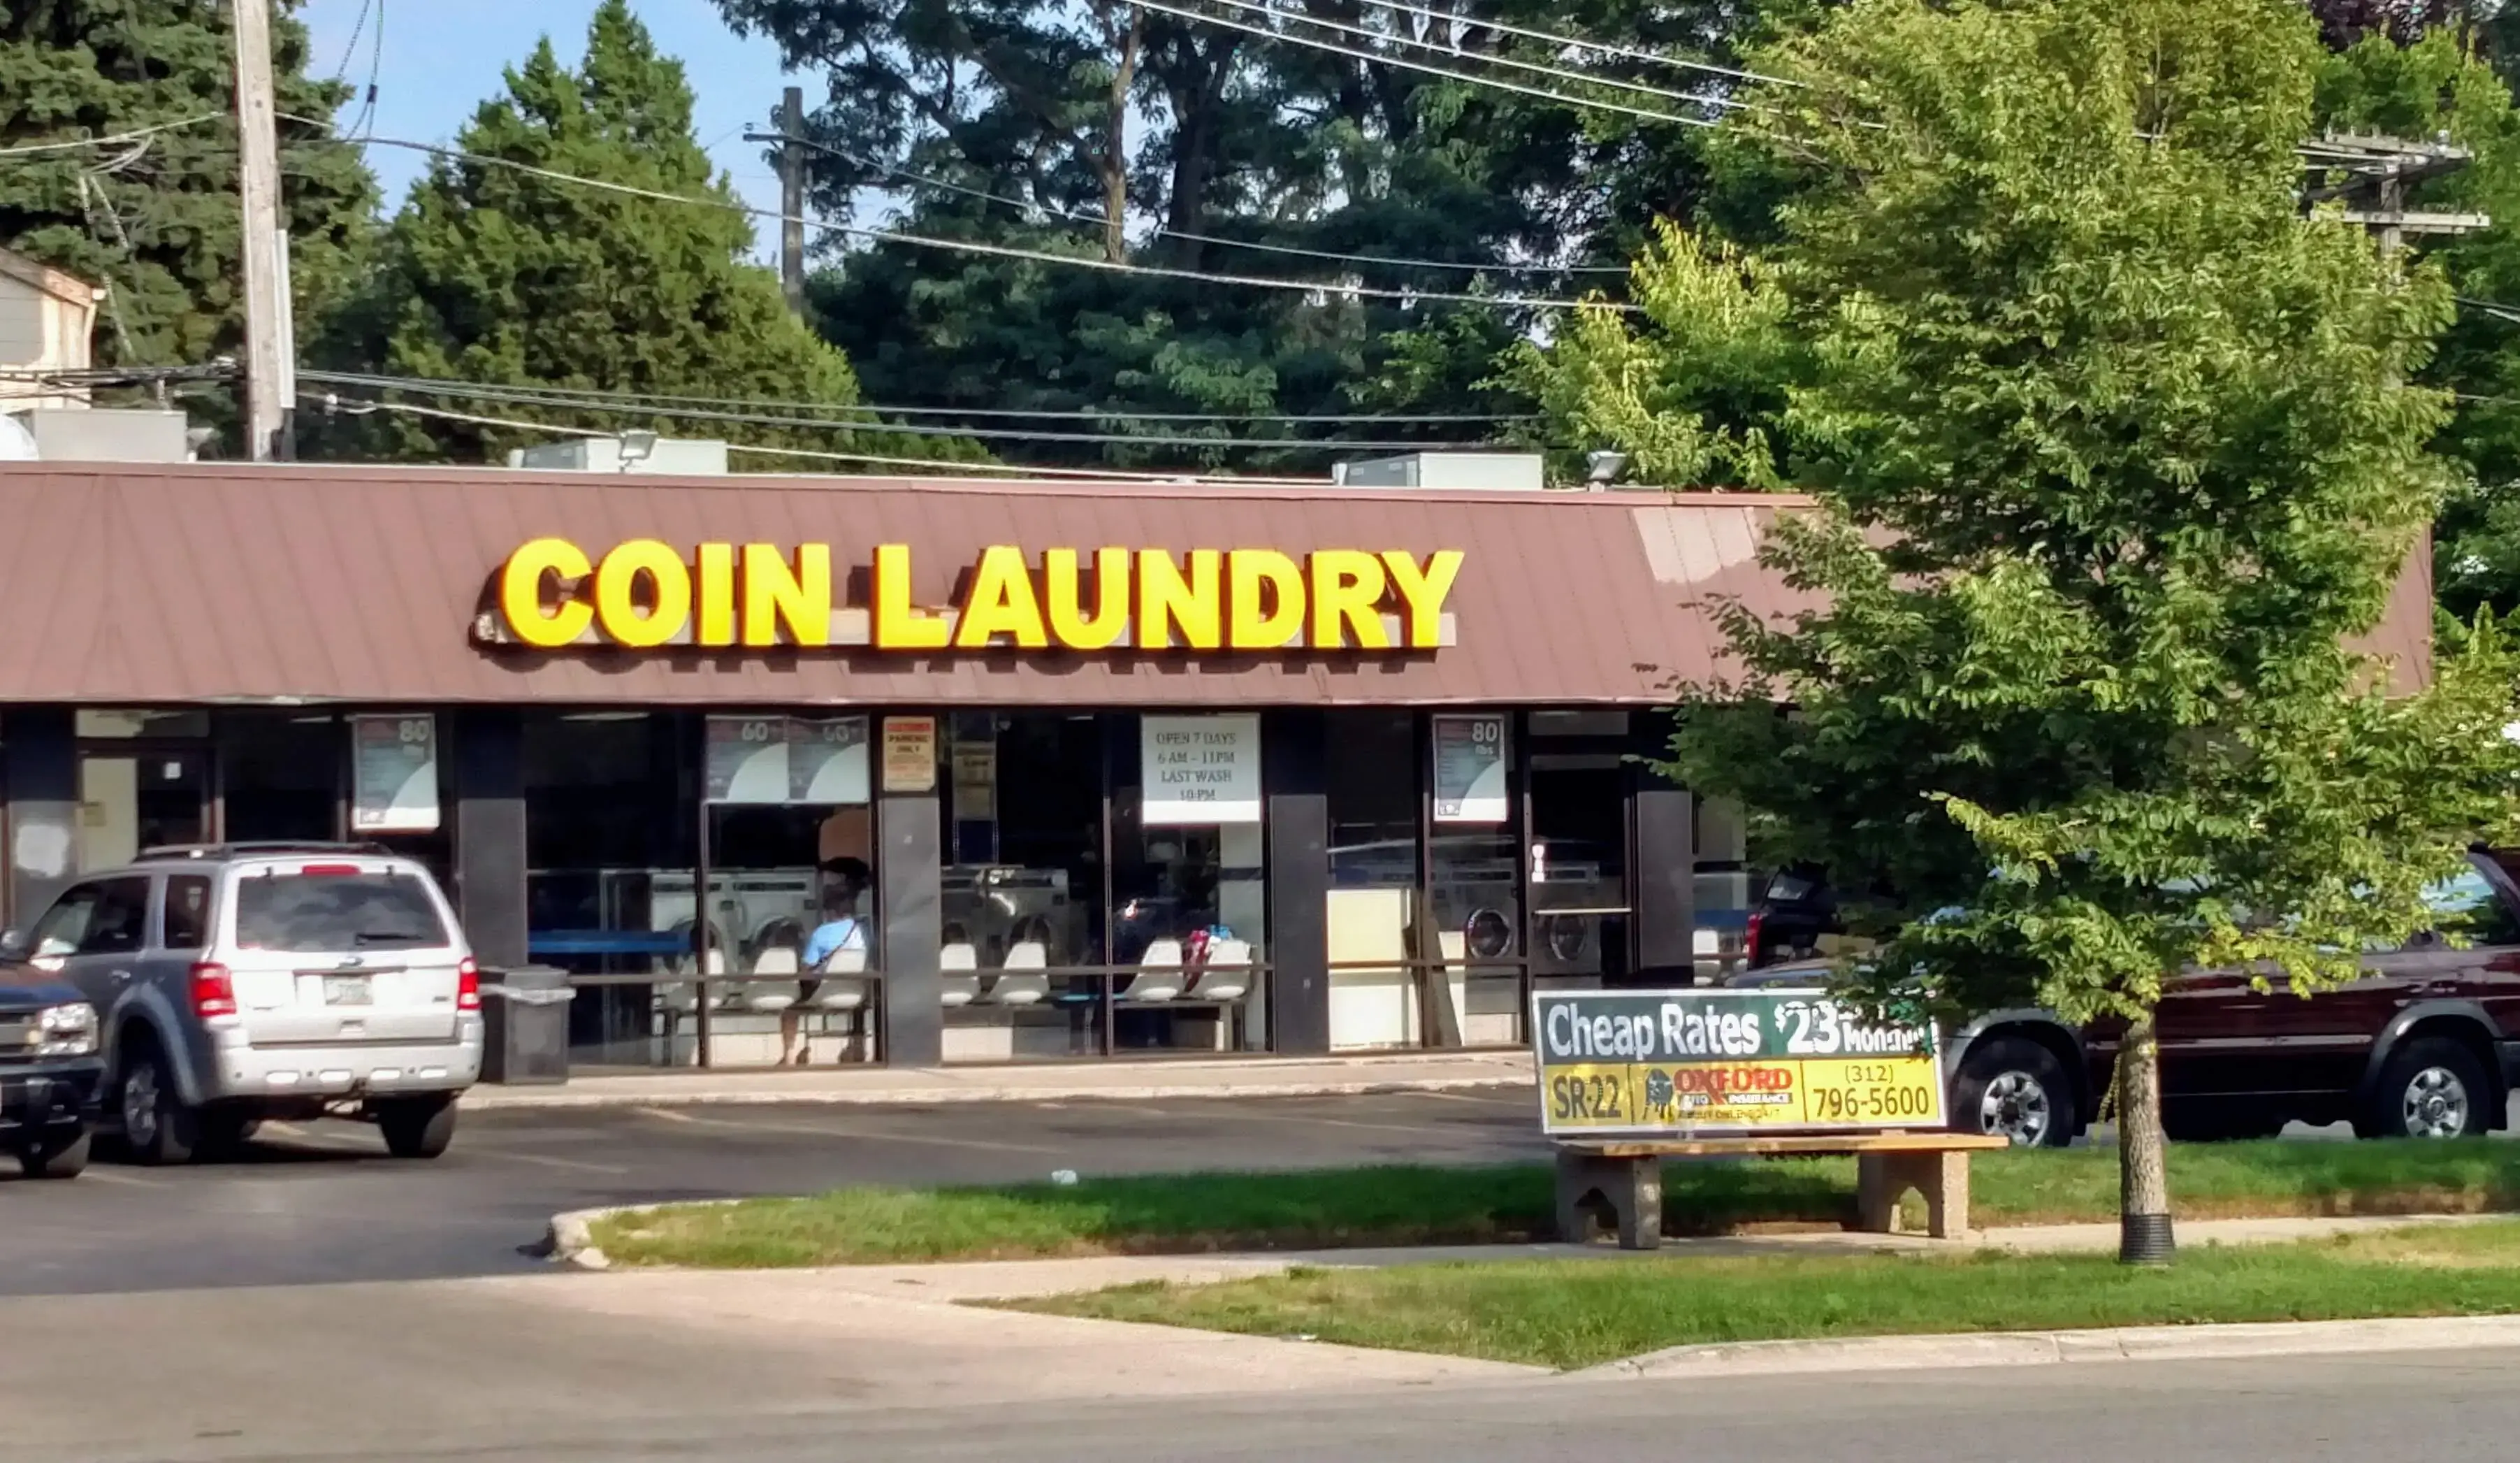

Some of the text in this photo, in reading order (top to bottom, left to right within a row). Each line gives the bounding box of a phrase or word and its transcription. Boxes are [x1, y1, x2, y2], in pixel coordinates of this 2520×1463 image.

[502, 539, 1465, 650] COIN LAUNDRY
[399, 721, 429, 742] 80
[741, 722, 768, 742] 60
[1157, 733, 1236, 744] OPEN 7 DAYS
[1472, 722, 1498, 742] 80
[1168, 751, 1188, 763] AM
[1161, 770, 1232, 783] LAST WASH
[1547, 1000, 1841, 1061] Cheap Rates $23
[1674, 1067, 1793, 1092] OXFORD
[1845, 1065, 1893, 1083] (312)
[1553, 1074, 1621, 1119] SR-22
[1813, 1086, 1929, 1118] 796-5600
